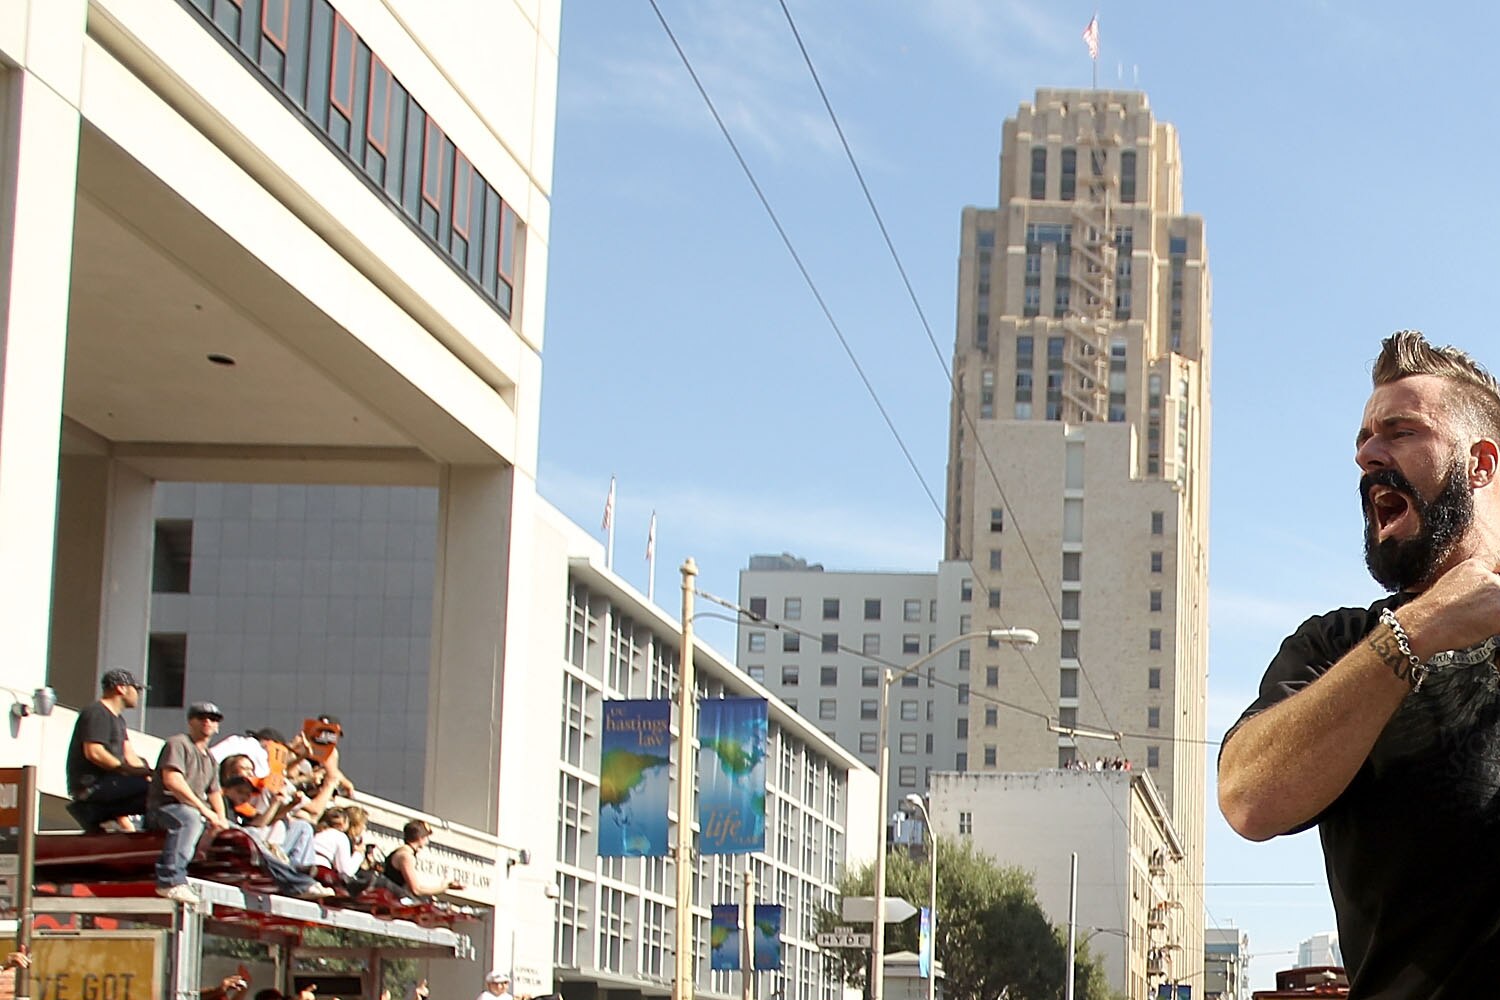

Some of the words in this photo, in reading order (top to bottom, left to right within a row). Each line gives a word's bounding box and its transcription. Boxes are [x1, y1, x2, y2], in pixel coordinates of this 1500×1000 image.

[605, 714, 667, 733] hastings
[638, 731, 664, 747] law
[705, 808, 742, 847] life
[822, 935, 866, 945] HYDE
